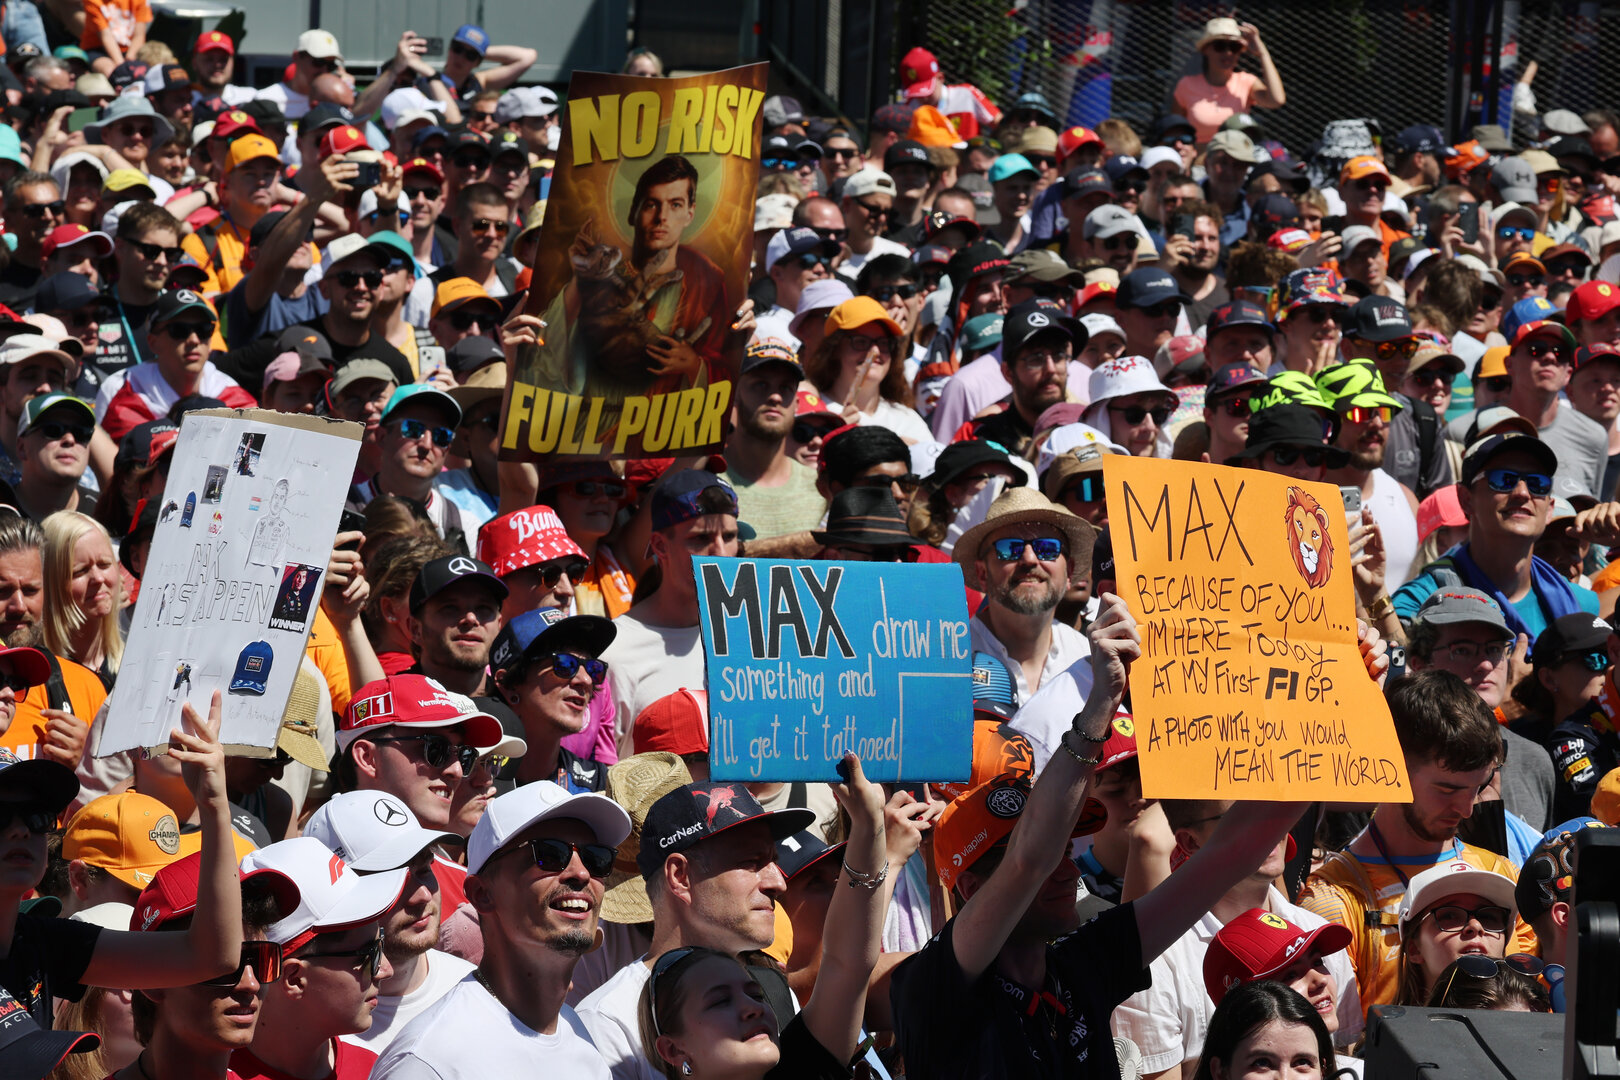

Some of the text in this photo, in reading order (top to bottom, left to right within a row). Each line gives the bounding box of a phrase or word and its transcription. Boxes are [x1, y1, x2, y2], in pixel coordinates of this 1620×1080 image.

[568, 84, 765, 167] NO RISK
[501, 380, 732, 455] FULL PURR
[1123, 478, 1254, 566] MAX
[700, 562, 969, 660] MAX draw me
[1136, 574, 1235, 614] BECAUSE
[1241, 583, 1273, 614] OF
[270, 617, 305, 633] WINNER
[1147, 617, 1168, 658] I'M
[1172, 617, 1232, 655] HERE
[720, 652, 877, 716] something and
[1153, 660, 1176, 698] AT
[1181, 657, 1210, 695] MY
[1215, 660, 1260, 696] First
[1305, 676, 1340, 707] GP.
[376, 697, 386, 714] 1
[713, 712, 899, 778] I'll get it tattooed
[1149, 718, 1160, 752] A
[1165, 715, 1213, 748] PHOTO
[1217, 710, 1251, 744] WITH
[1214, 747, 1275, 791] MEAN
[1280, 748, 1323, 784] THE
[659, 821, 704, 849] CarNext
[781, 836, 802, 853] 1
[960, 828, 989, 858] viaplay
[1286, 936, 1306, 957] 44
